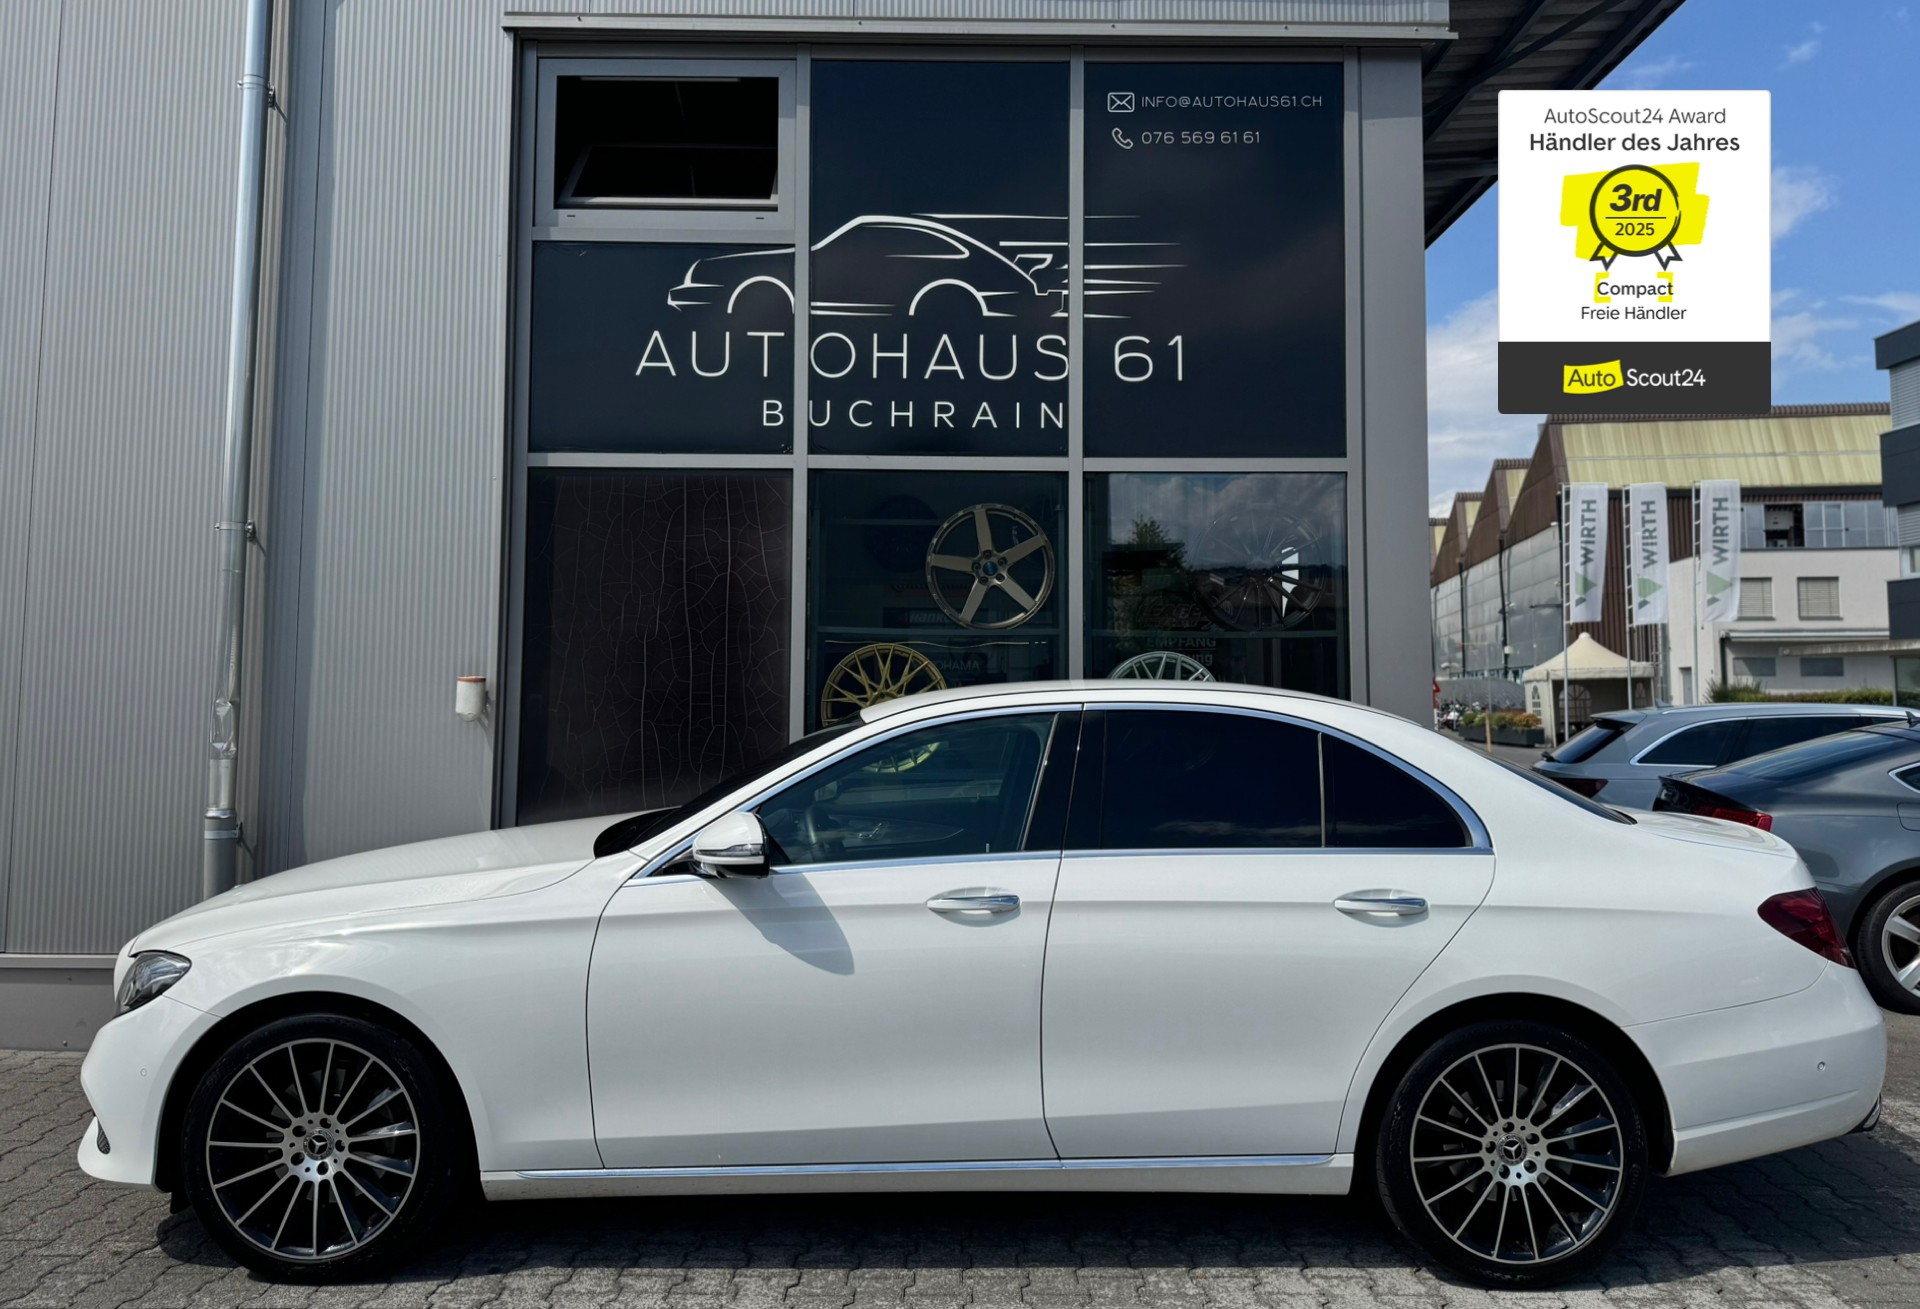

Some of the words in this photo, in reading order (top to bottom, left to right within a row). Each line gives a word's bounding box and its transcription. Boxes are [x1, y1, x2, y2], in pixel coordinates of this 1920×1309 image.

[1141, 96, 1323, 108] INFO@AUTOHAUS61.CH
[1141, 131, 1175, 144] 076
[1181, 131, 1215, 144] 569
[1220, 131, 1238, 144] 61
[1243, 131, 1260, 144] 61
[635, 330, 1069, 381] AUTOHAUS
[1114, 335, 1183, 382] 61
[762, 399, 1064, 429] BUCHRAIN
[1580, 499, 1597, 566] WIRTH
[1640, 500, 1658, 569] WIRTH
[1712, 497, 1729, 566] WIRTH
